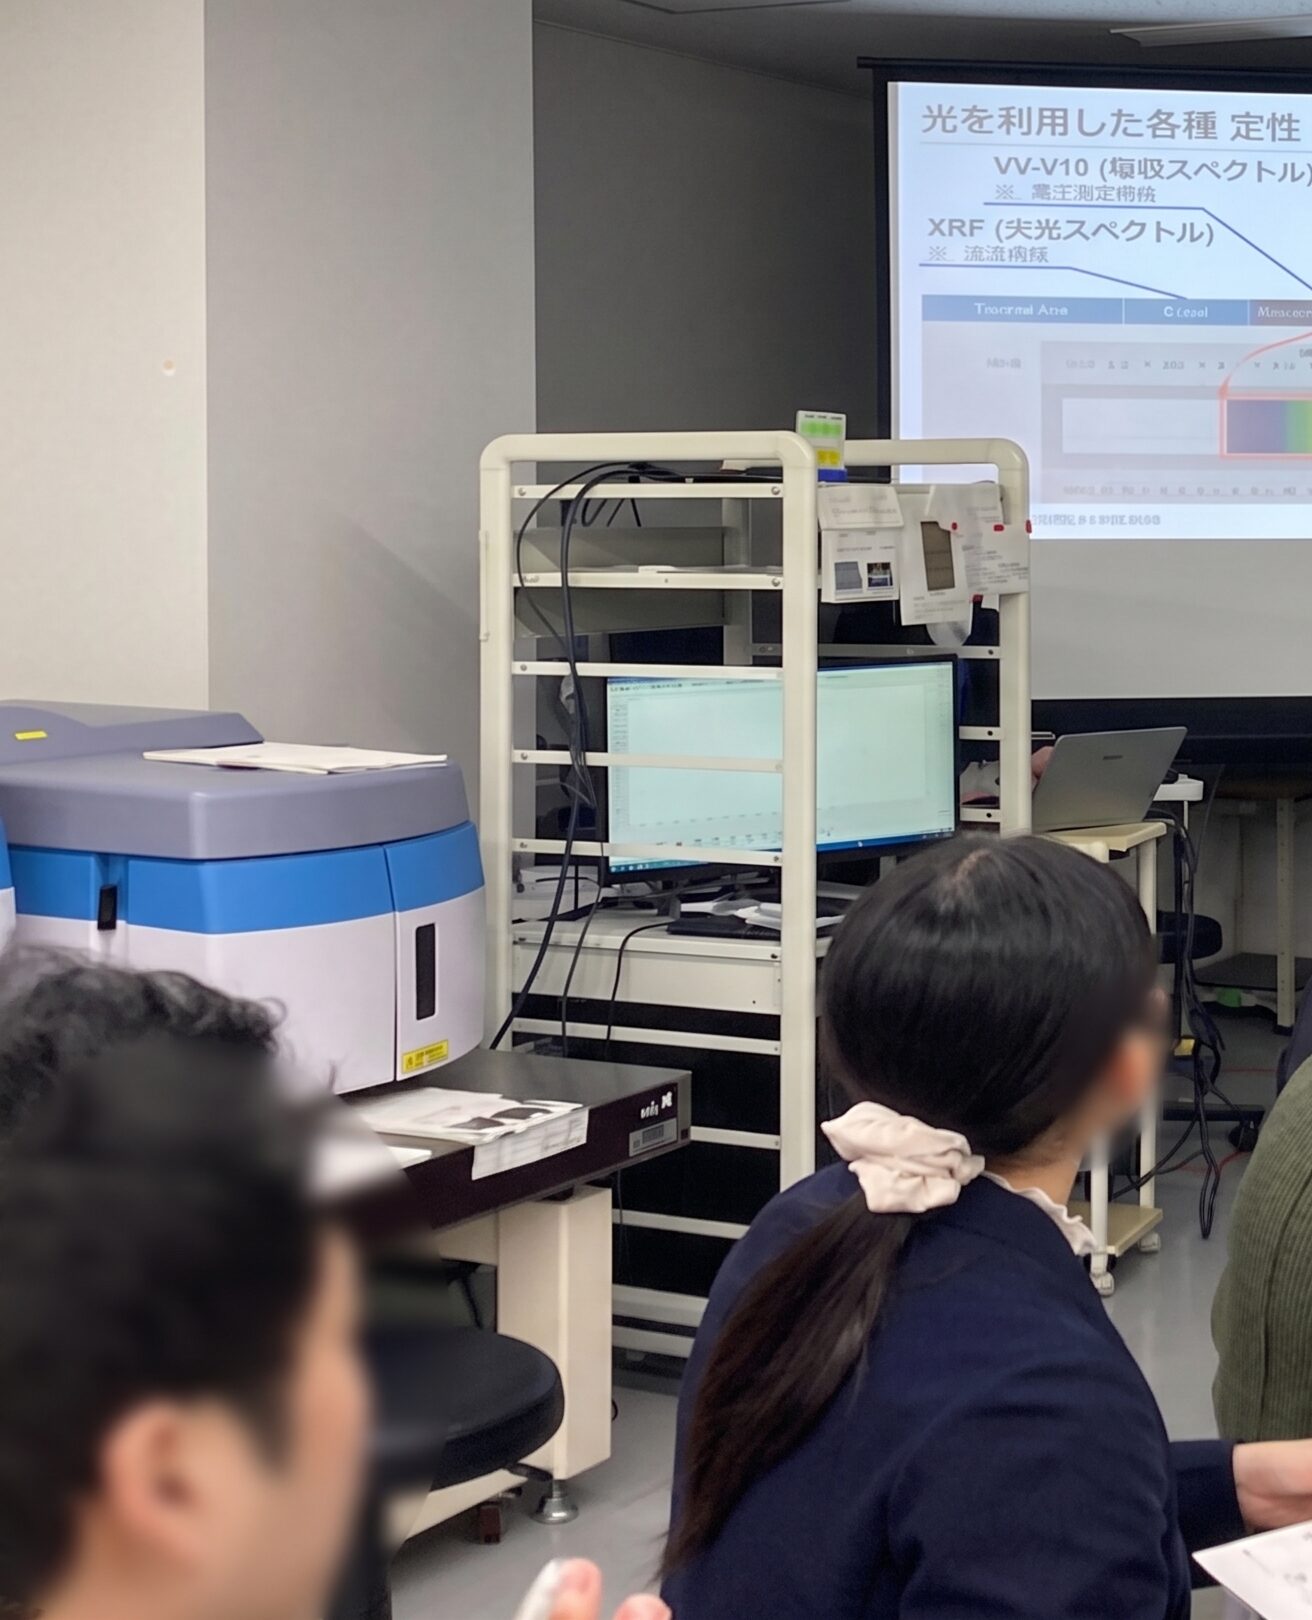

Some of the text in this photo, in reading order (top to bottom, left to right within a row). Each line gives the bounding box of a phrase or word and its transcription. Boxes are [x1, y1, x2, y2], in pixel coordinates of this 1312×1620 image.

[921, 103, 1218, 140] 光を利用した各種
[927, 217, 985, 238] XRF
